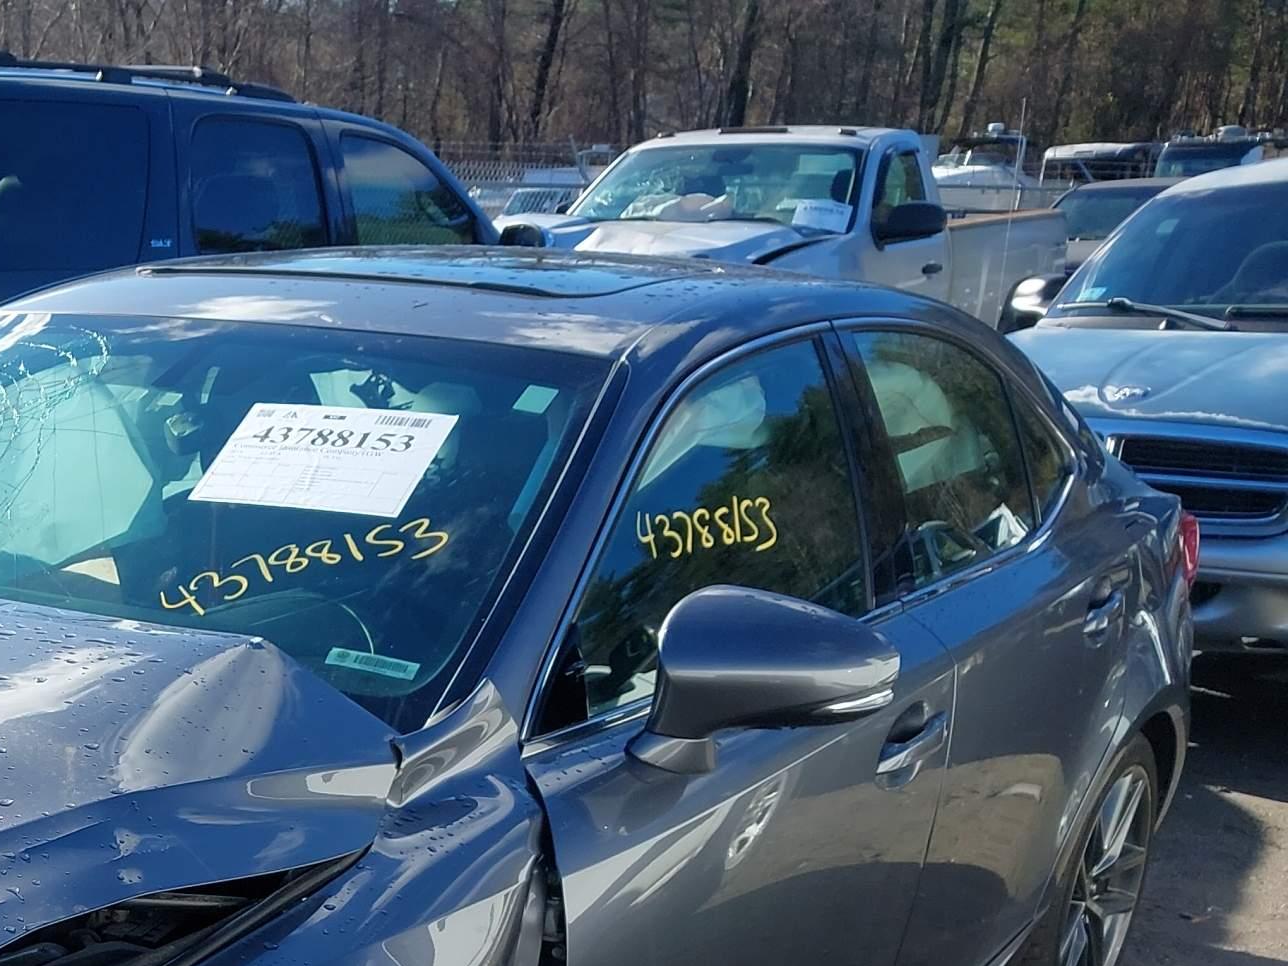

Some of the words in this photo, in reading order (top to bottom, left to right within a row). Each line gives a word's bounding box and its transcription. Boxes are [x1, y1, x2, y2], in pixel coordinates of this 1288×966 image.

[252, 425, 415, 453] 43788153
[637, 496, 777, 559] 43788153
[160, 518, 449, 616] 43788153
